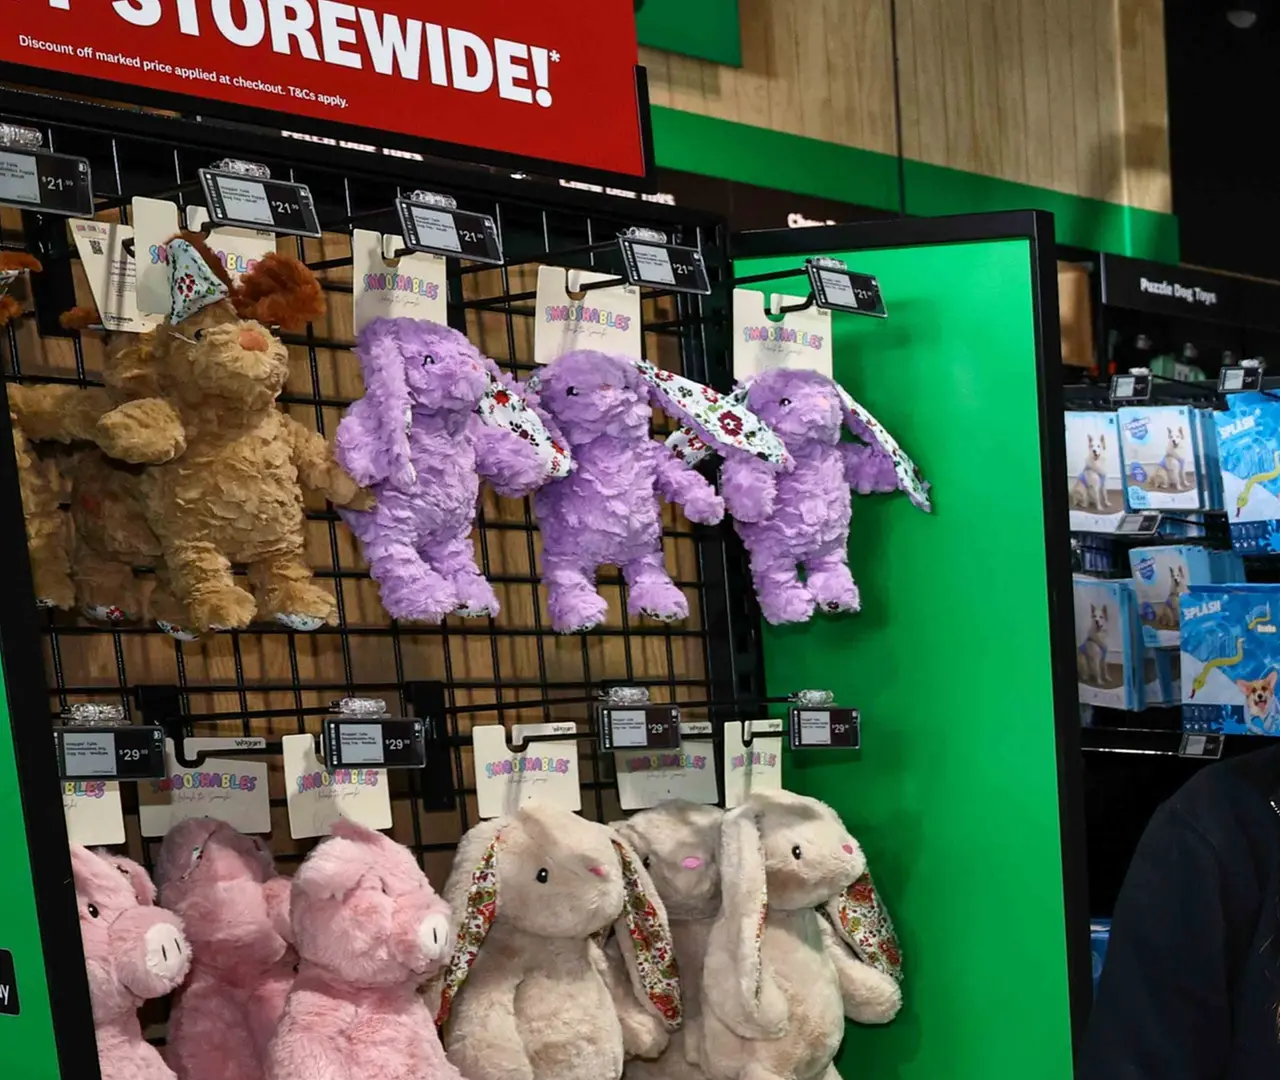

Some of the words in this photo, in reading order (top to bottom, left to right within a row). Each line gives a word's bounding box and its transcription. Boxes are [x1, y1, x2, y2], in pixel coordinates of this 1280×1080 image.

[19, 34, 74, 56] Discount
[76, 47, 93, 59] off
[95, 52, 141, 68] marked
[143, 60, 173, 75] price
[174, 65, 217, 84] applied
[219, 74, 231, 86] at
[233, 76, 286, 96] checkout.
[288, 86, 315, 101] T&Cs
[317, 93, 349, 109] apply.
[1140, 277, 1173, 297] Puzzle
[1174, 283, 1191, 302] Dog
[1192, 288, 1217, 305] Toys
[1182, 600, 1221, 621] SPLASH
